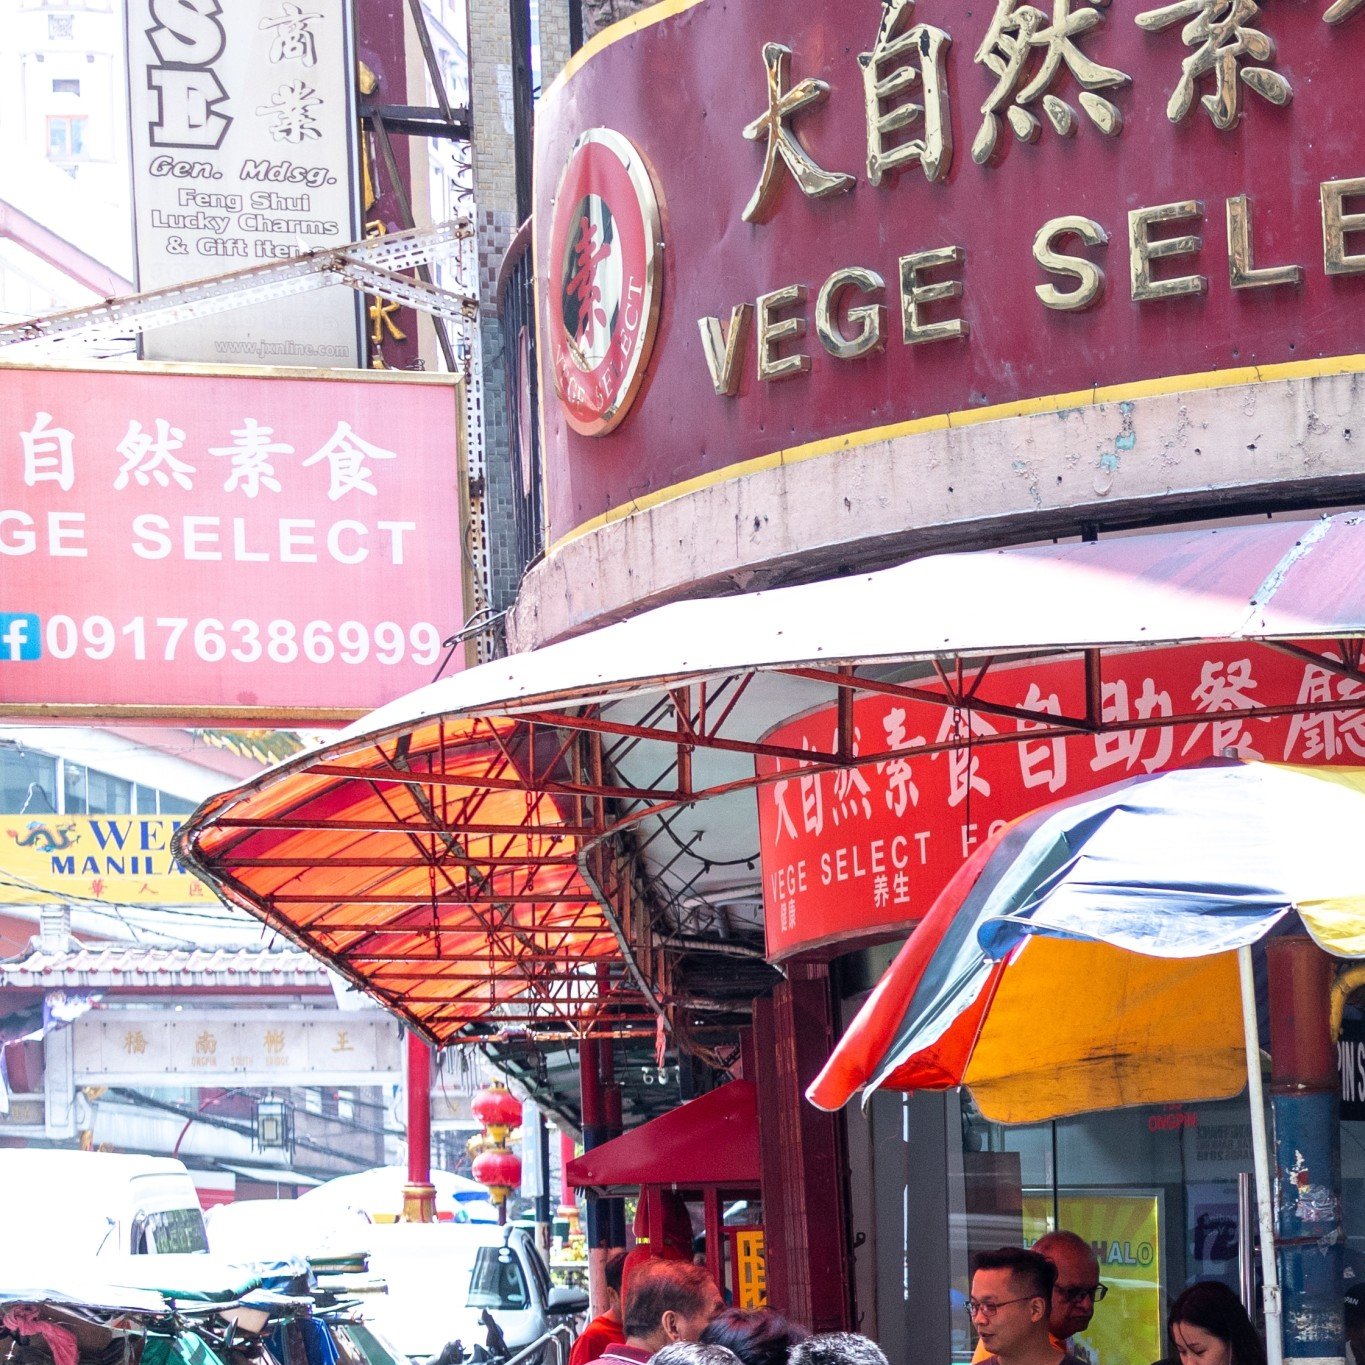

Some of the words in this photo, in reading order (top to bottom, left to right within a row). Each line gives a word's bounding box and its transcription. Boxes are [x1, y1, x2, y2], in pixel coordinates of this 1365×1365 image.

[149, 155, 223, 180] Gen.
[240, 159, 338, 188] Mdsg.
[179, 188, 244, 213] Feng
[251, 191, 311, 212] Shui
[151, 210, 230, 234] Lucky
[238, 213, 339, 235] Charms
[166, 236, 189, 255] &
[197, 237, 248, 257] Gift
[698, 246, 971, 397] VEGE
[19, 411, 398, 501] 自然素食
[132, 514, 416, 565] SELECT
[46, 615, 441, 665] 09176386999
[770, 861, 808, 903] VEGE
[822, 829, 930, 885] SELECT
[873, 873, 910, 907] 养生
